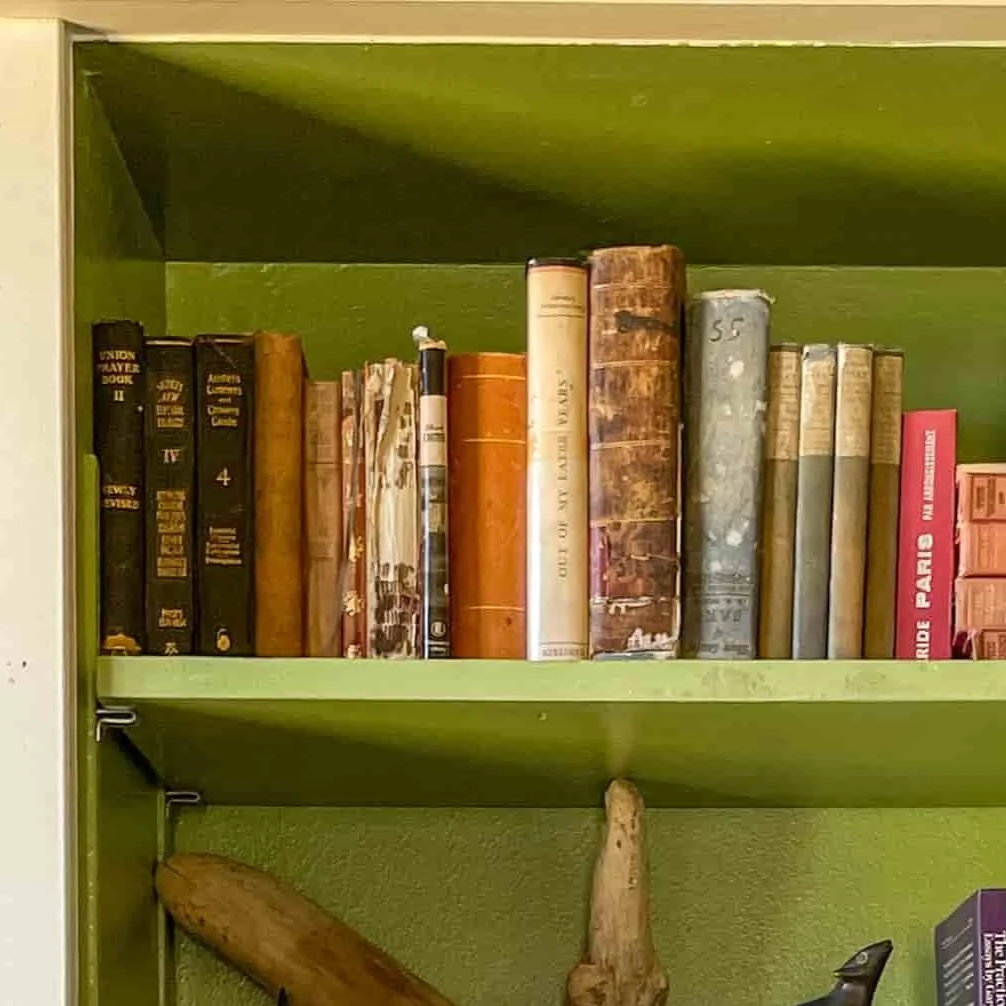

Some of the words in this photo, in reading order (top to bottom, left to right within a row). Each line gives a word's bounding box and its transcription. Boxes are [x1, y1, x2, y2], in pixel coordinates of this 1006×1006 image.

[557, 490, 569, 512] MY
[558, 520, 569, 539] OF
[558, 551, 569, 579] OUT
[911, 534, 934, 609] PARIS
[911, 620, 931, 661] RIDE
